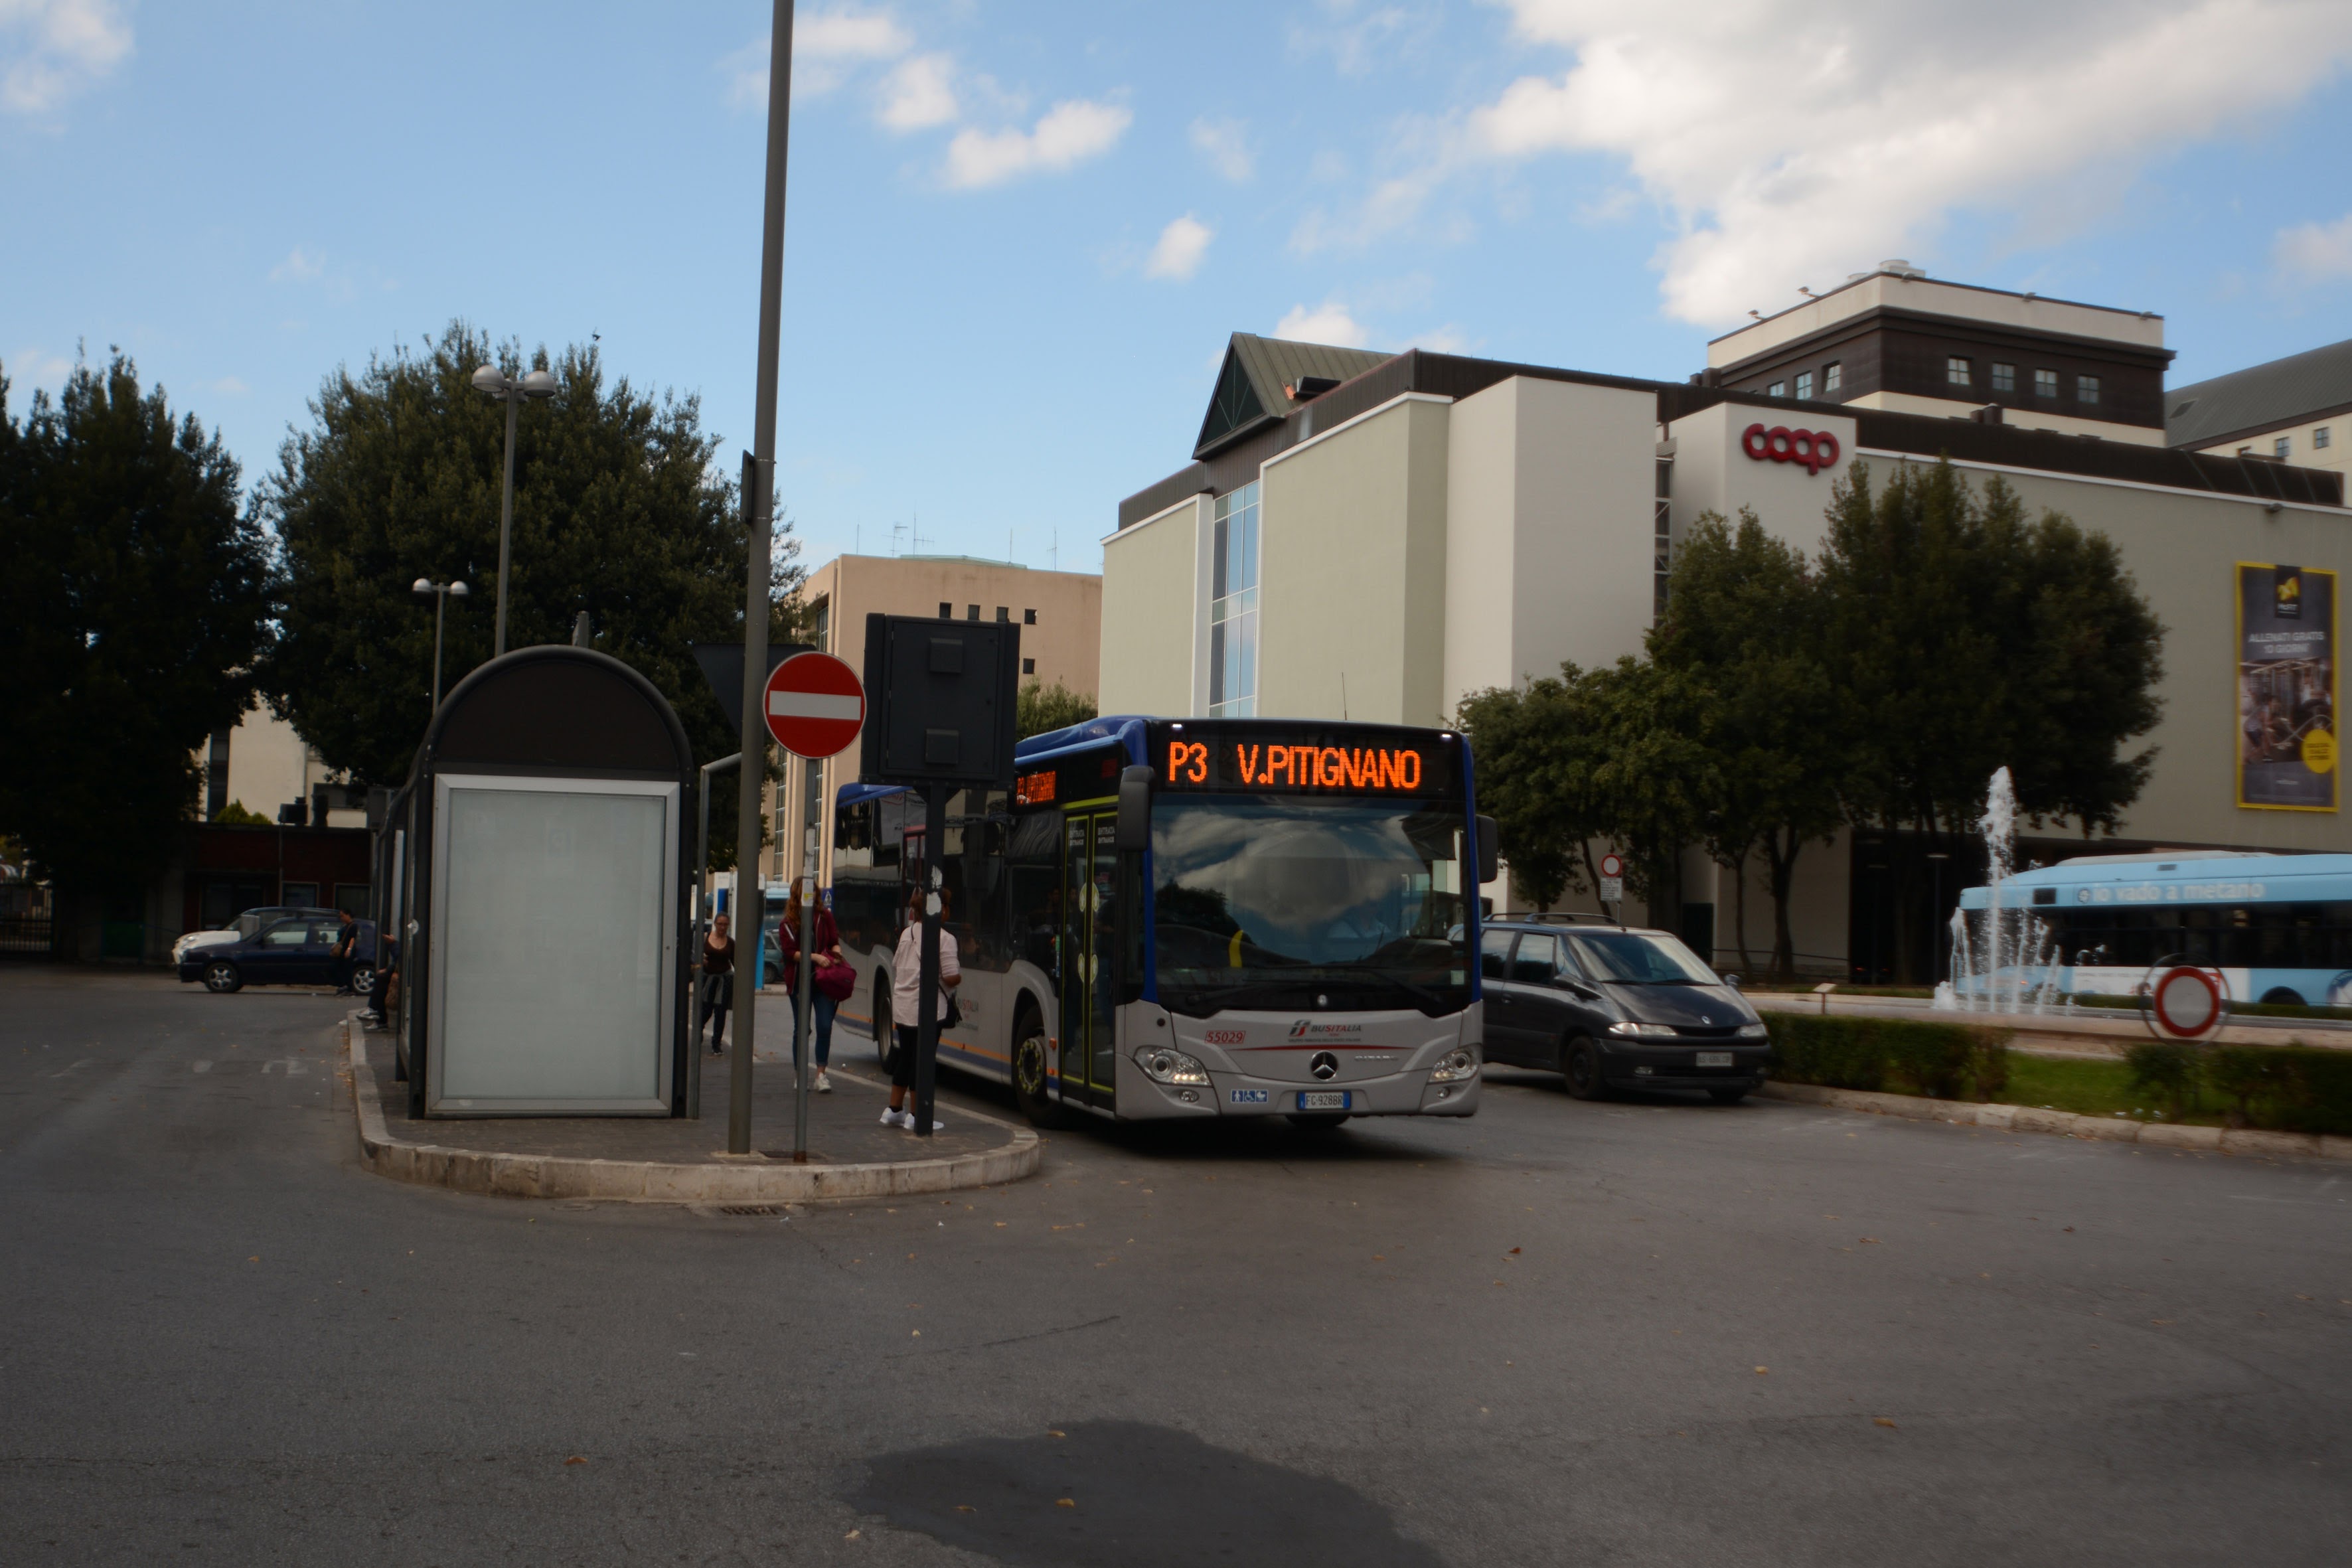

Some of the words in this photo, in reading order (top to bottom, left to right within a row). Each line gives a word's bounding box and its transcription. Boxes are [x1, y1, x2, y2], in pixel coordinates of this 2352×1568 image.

[1742, 423, 1840, 475] coop
[2248, 633, 2290, 643] ALLENATI
[2293, 631, 2325, 641] GRATIS
[2264, 645, 2273, 653] 10
[1168, 742, 1208, 782] P3
[1237, 744, 1421, 788] V.PITIGNANO
[2093, 884, 2110, 902] io
[2115, 882, 2162, 901] vado
[2166, 886, 2177, 900] a
[2184, 882, 2265, 900] metano
[1207, 1032, 1243, 1042] 55029
